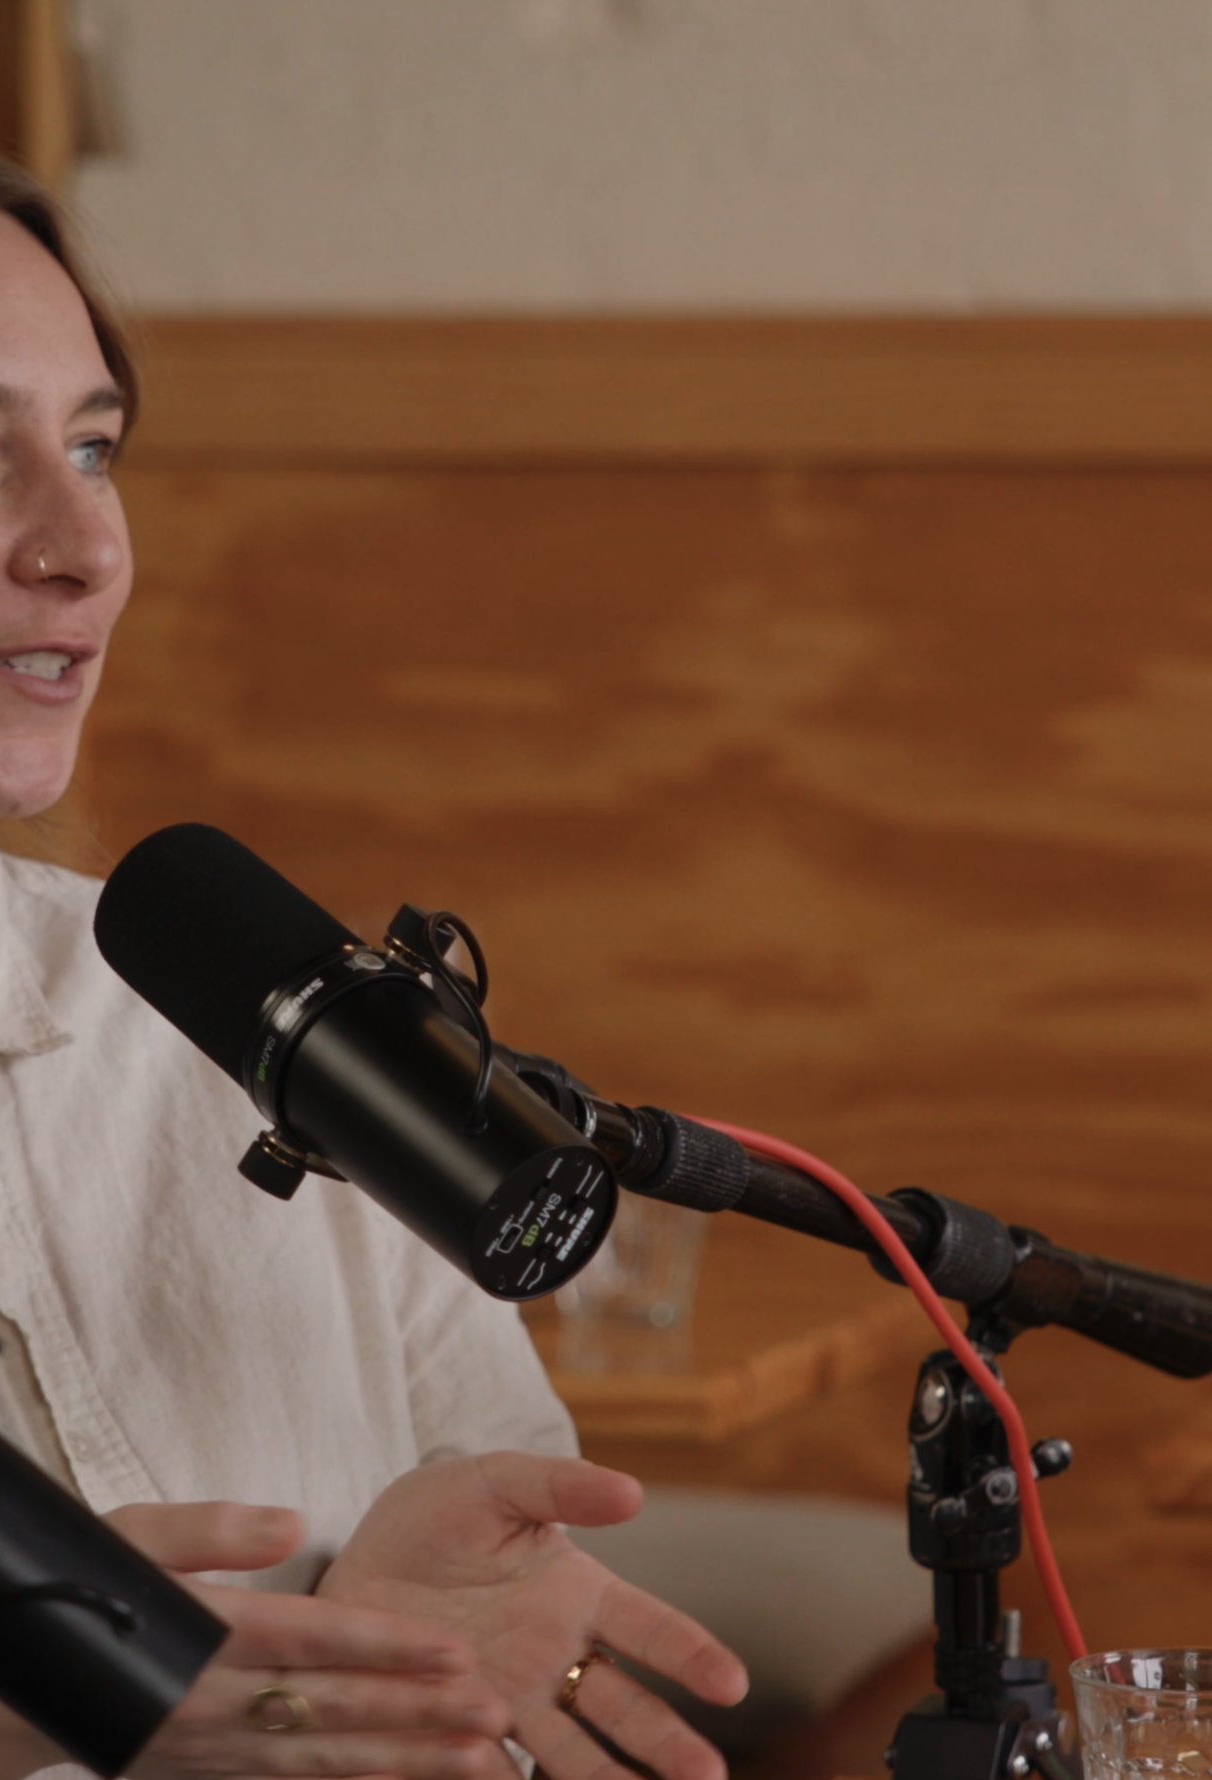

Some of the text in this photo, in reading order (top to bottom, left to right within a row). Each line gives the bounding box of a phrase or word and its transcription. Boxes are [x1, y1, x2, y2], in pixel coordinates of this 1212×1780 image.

[275, 977, 324, 1032] SHURE
[257, 1036, 275, 1082] SM7dB
[522, 1193, 562, 1246] SM7dB
[556, 1207, 594, 1261] SHURE
